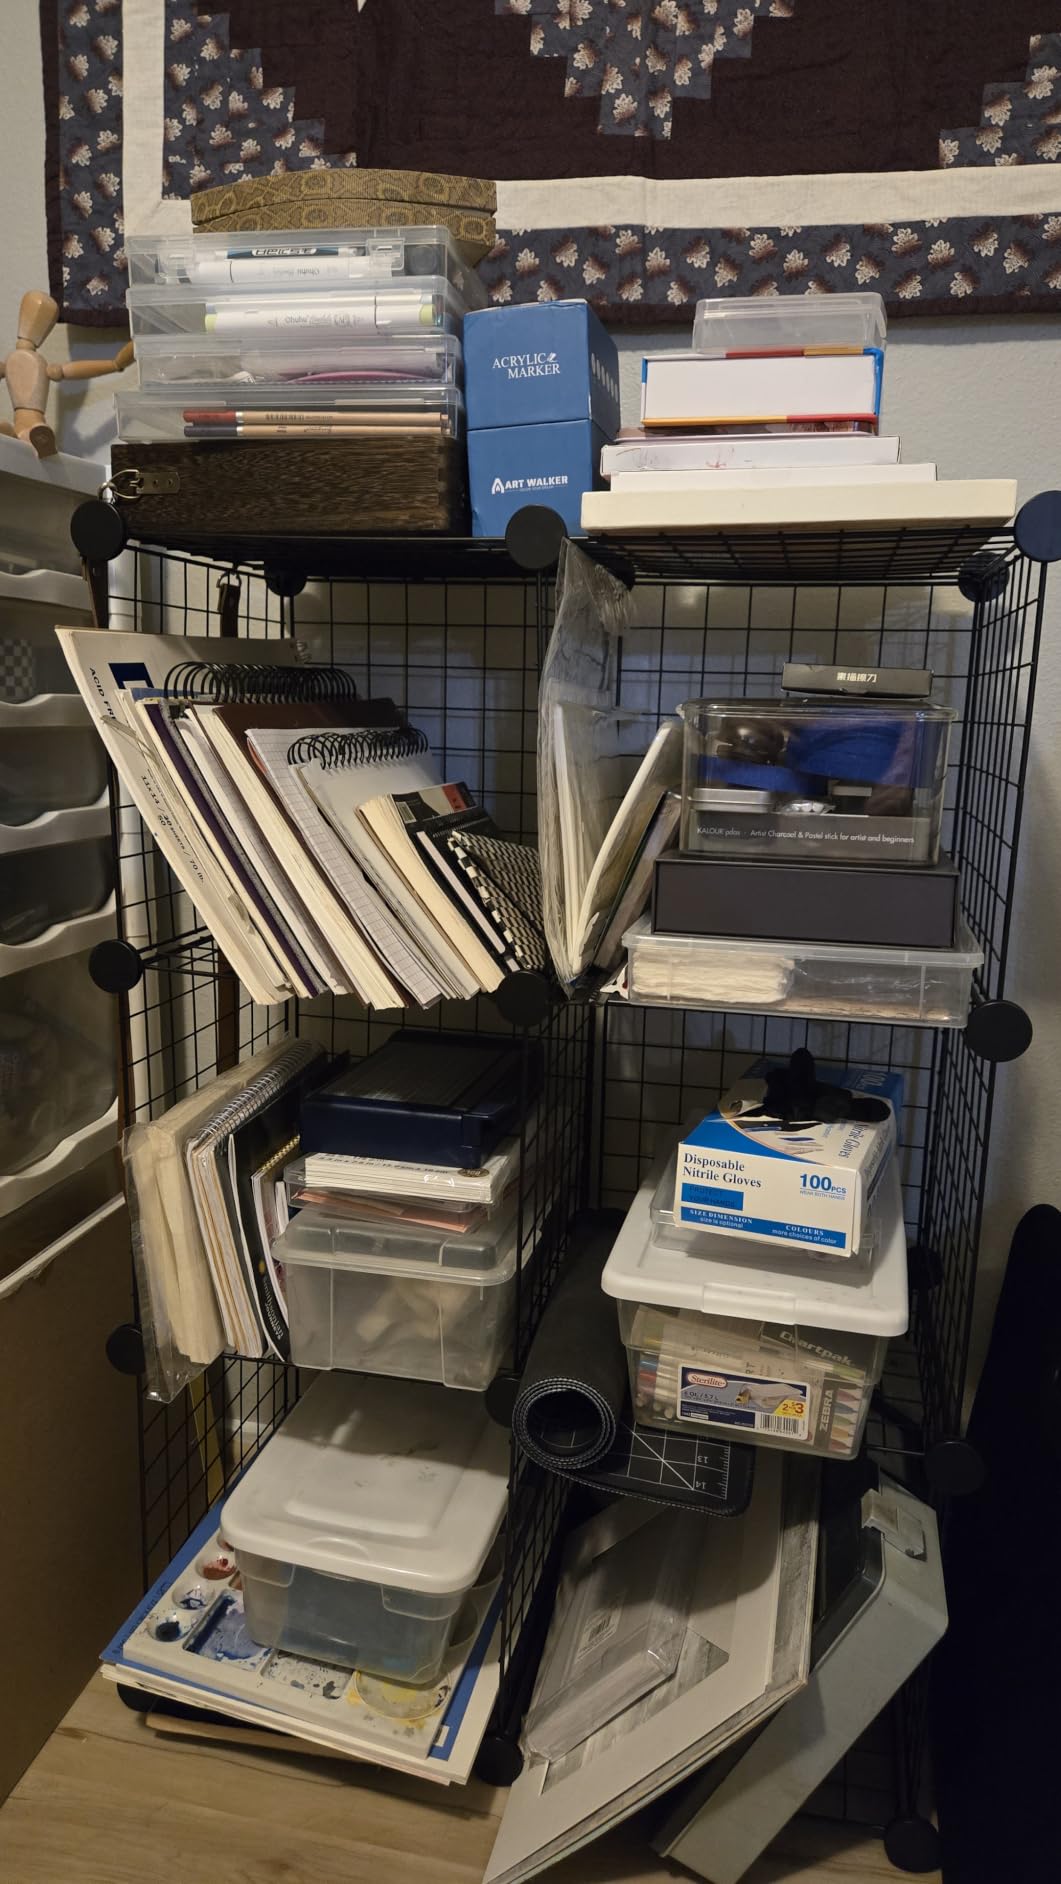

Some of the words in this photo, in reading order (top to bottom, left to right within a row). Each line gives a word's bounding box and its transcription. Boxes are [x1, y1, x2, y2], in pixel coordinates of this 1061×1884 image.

[492, 352, 546, 369] ACRYLIC
[508, 363, 561, 379] MARKER
[505, 480, 525, 489] ART
[527, 475, 568, 487] WALKER
[89, 667, 105, 697] ACID
[768, 829, 797, 839] Charcoal
[804, 831, 824, 840] Pastel
[824, 832, 839, 840] stick
[840, 832, 850, 841] for
[867, 833, 881, 842] and
[882, 834, 915, 844] beginners
[684, 1152, 745, 1172] Disposable
[683, 1165, 720, 1181] Nitrile
[722, 1172, 762, 1188] Gloves
[689, 1209, 708, 1217] SIZE
[708, 1212, 753, 1224] DIMENSION
[719, 1219, 744, 1229] optional
[785, 1224, 824, 1236] COLOURS
[788, 1231, 813, 1240] choices
[691, 1374, 724, 1386] Sterilite
[820, 1389, 834, 1432] ZEBRA
[697, 1455, 709, 1464] 13
[695, 1480, 707, 1490] 14
